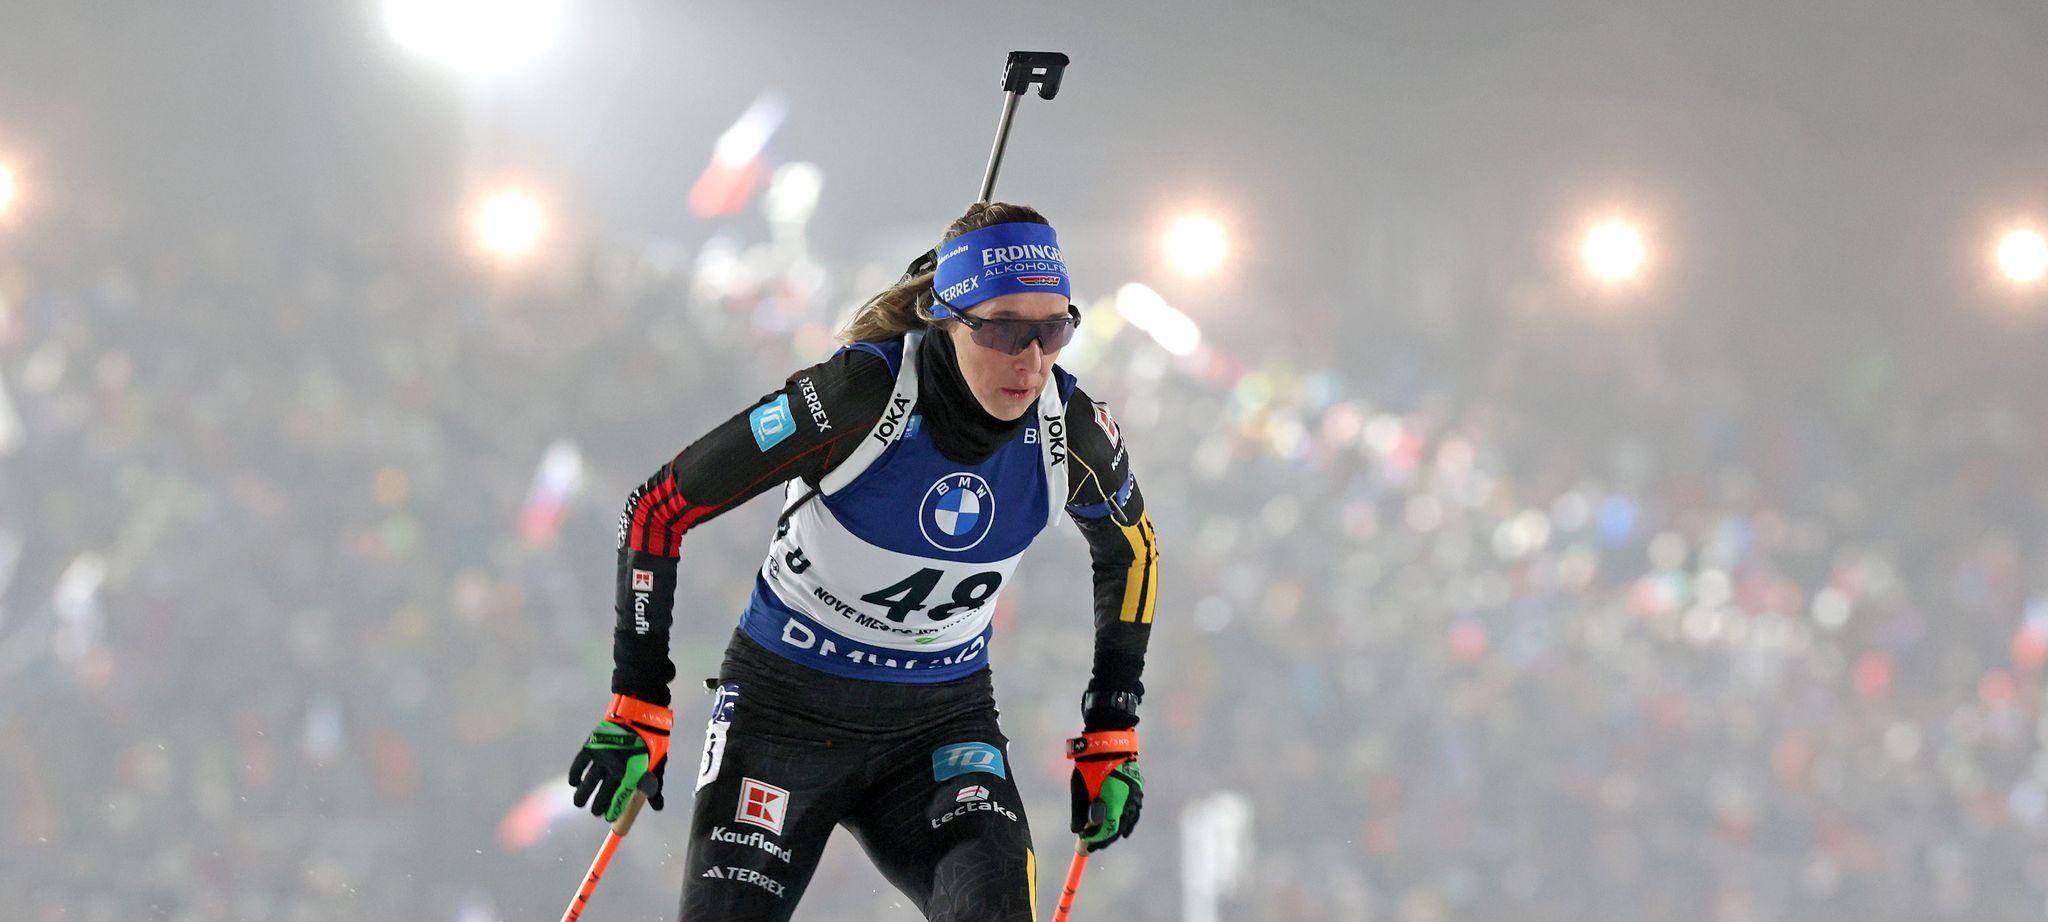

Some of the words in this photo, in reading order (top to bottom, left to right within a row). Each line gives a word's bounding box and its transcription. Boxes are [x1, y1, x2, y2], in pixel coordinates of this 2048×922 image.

[982, 244, 1064, 266] ERDINGE
[800, 381, 832, 433] TERREX
[873, 397, 911, 447] JOKA
[1044, 414, 1066, 467] JOKA
[936, 476, 987, 499] BMW
[634, 592, 650, 635] Kaufl
[813, 586, 857, 619] NOVE
[860, 567, 1003, 623] 48
[931, 801, 1018, 829] tectake
[710, 826, 792, 863] Kaufland
[726, 866, 786, 898] TERREX
